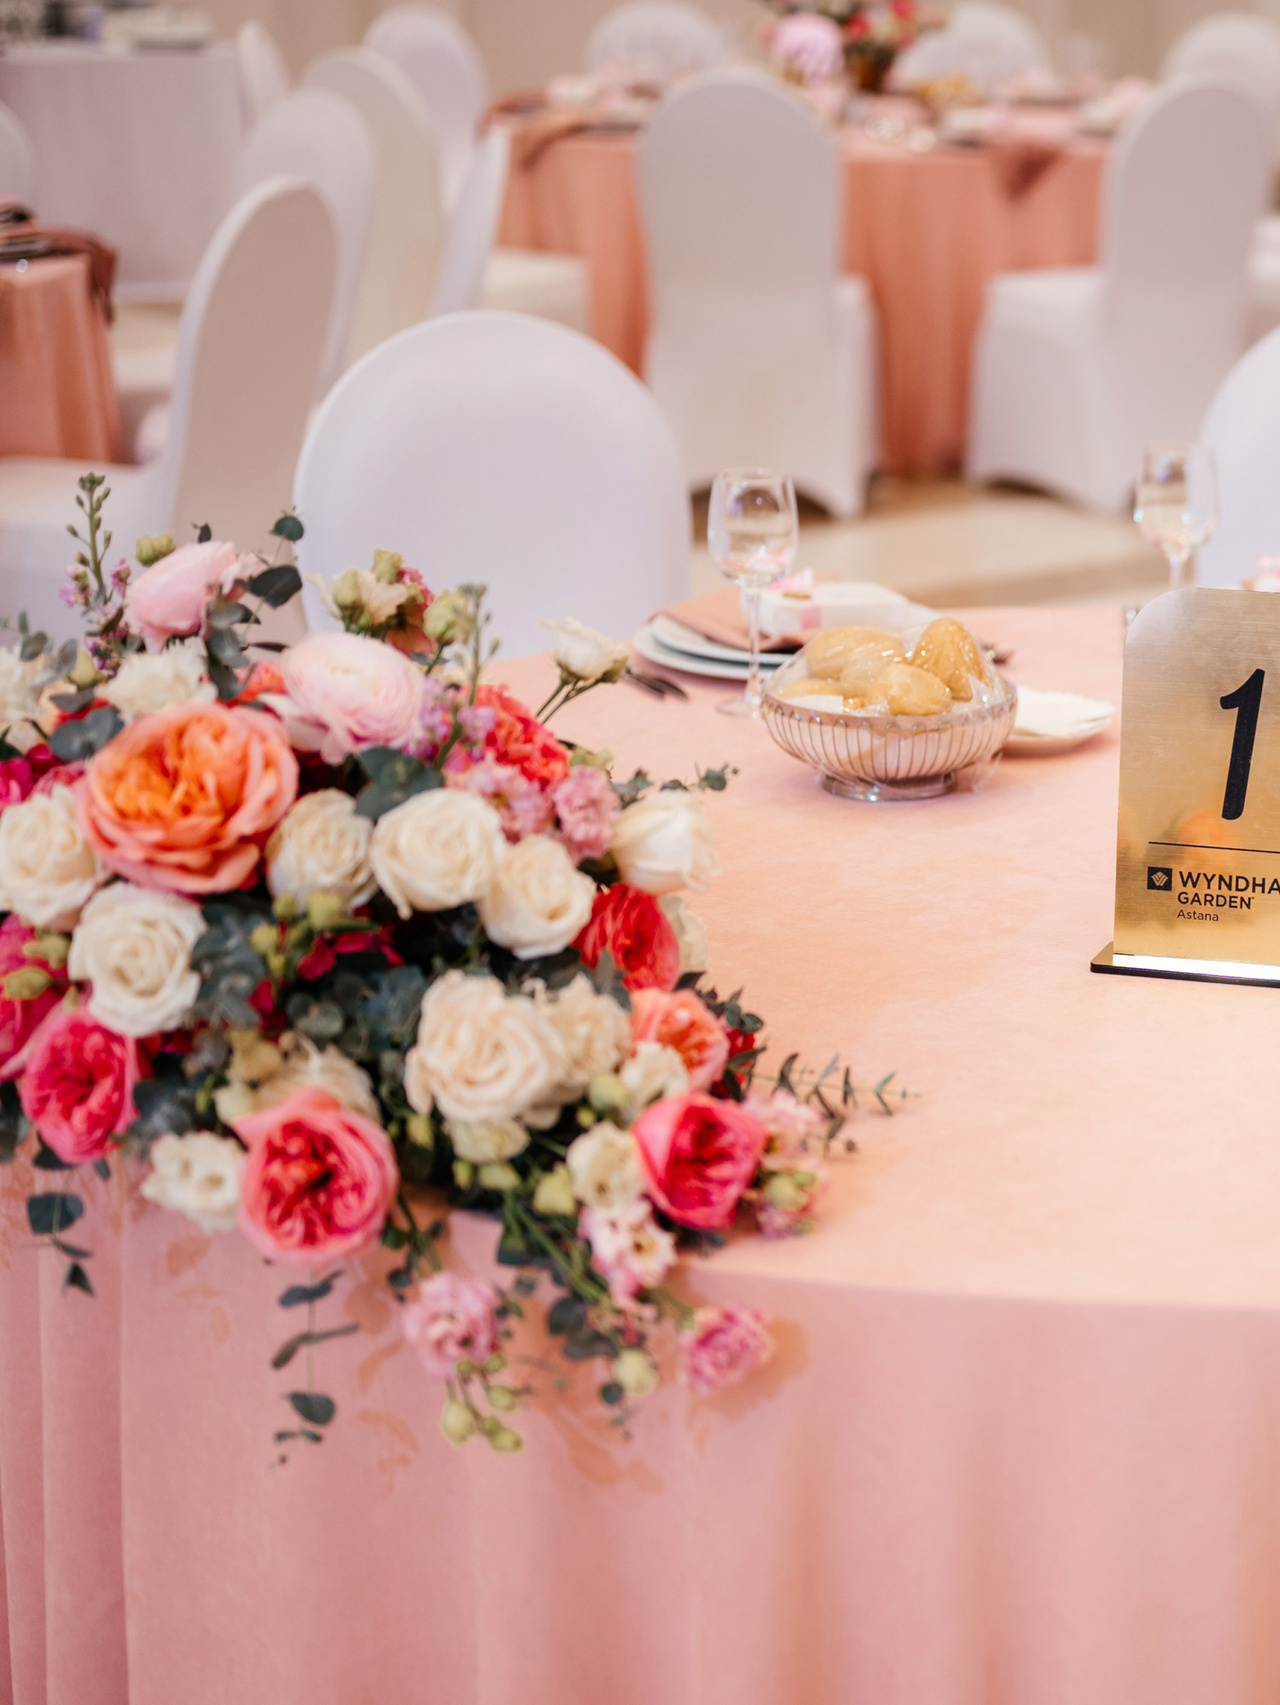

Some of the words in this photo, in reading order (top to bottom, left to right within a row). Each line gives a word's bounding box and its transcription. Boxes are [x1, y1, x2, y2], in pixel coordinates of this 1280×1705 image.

[1219, 668, 1266, 821] 1
[1177, 891, 1252, 910] GARDEN
[1176, 909, 1219, 922] Astana
